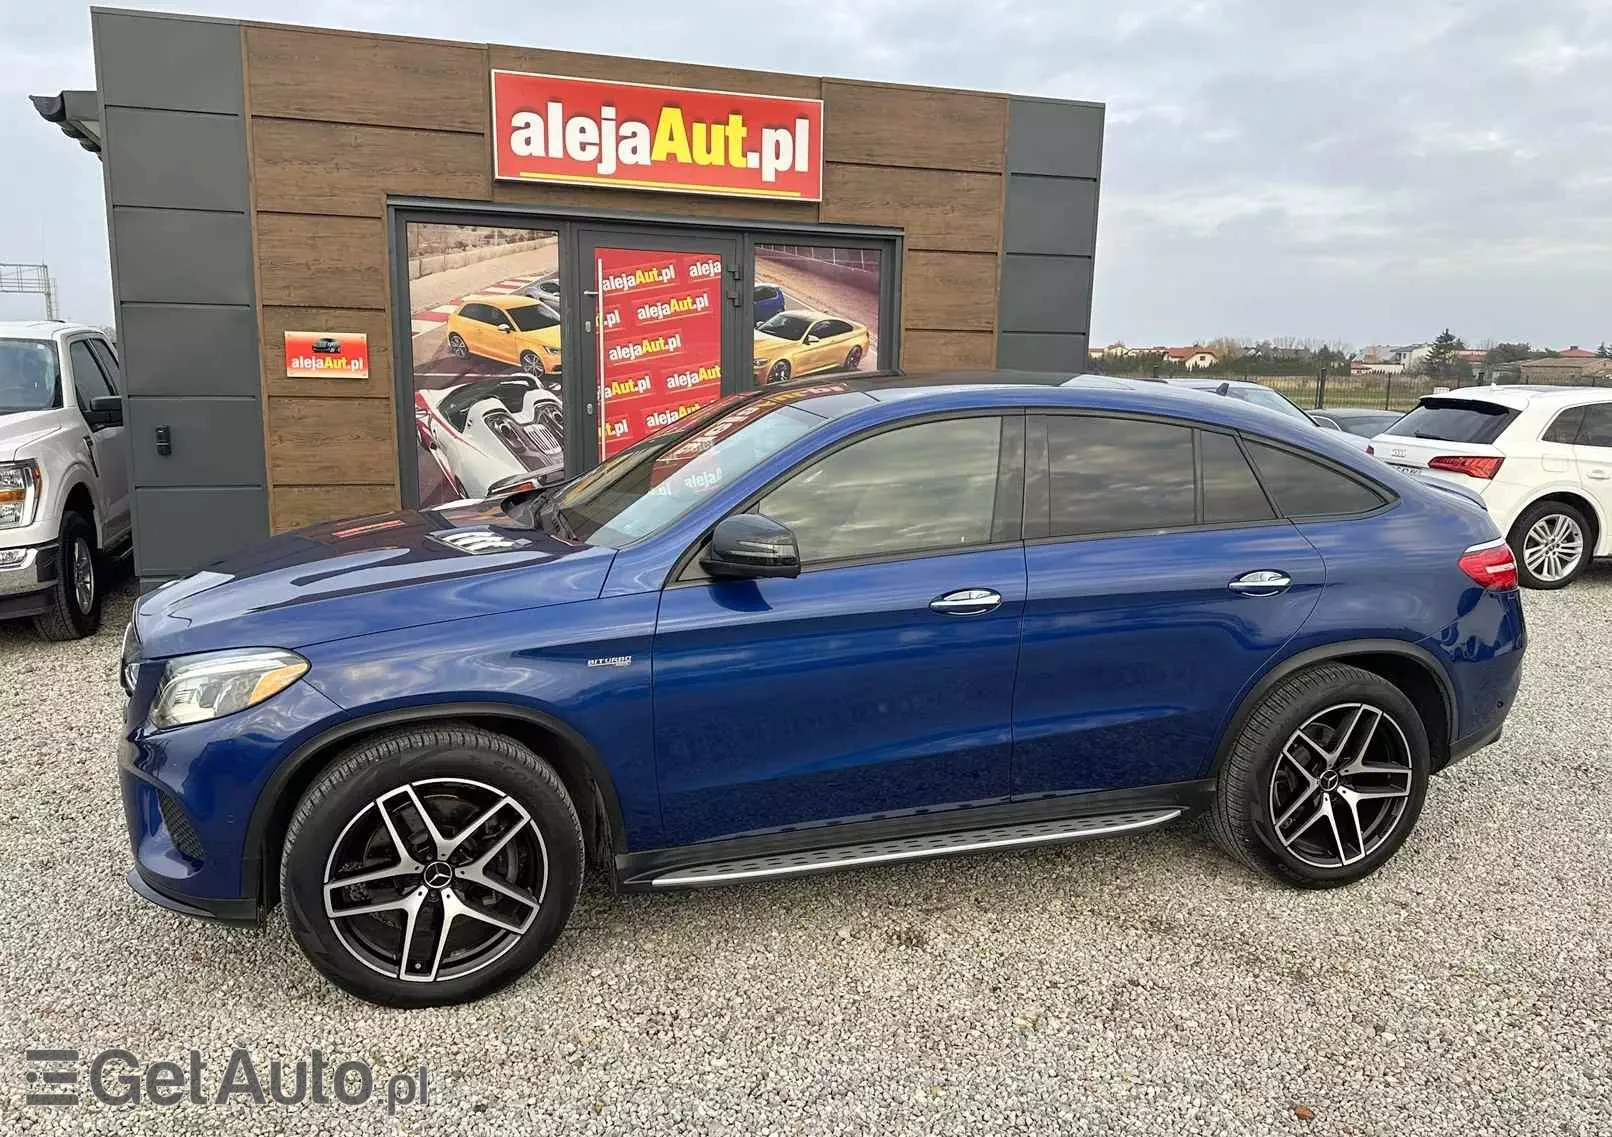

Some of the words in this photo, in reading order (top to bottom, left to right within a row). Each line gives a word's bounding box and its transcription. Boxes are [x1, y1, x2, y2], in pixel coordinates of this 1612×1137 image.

[510, 101, 809, 182] alejaAut.pl
[602, 264, 675, 291] alejaAut.pl
[637, 293, 709, 319] alejaAut.pl
[609, 334, 681, 360] alejaAut.pl
[291, 355, 364, 371] alejaAut.pl
